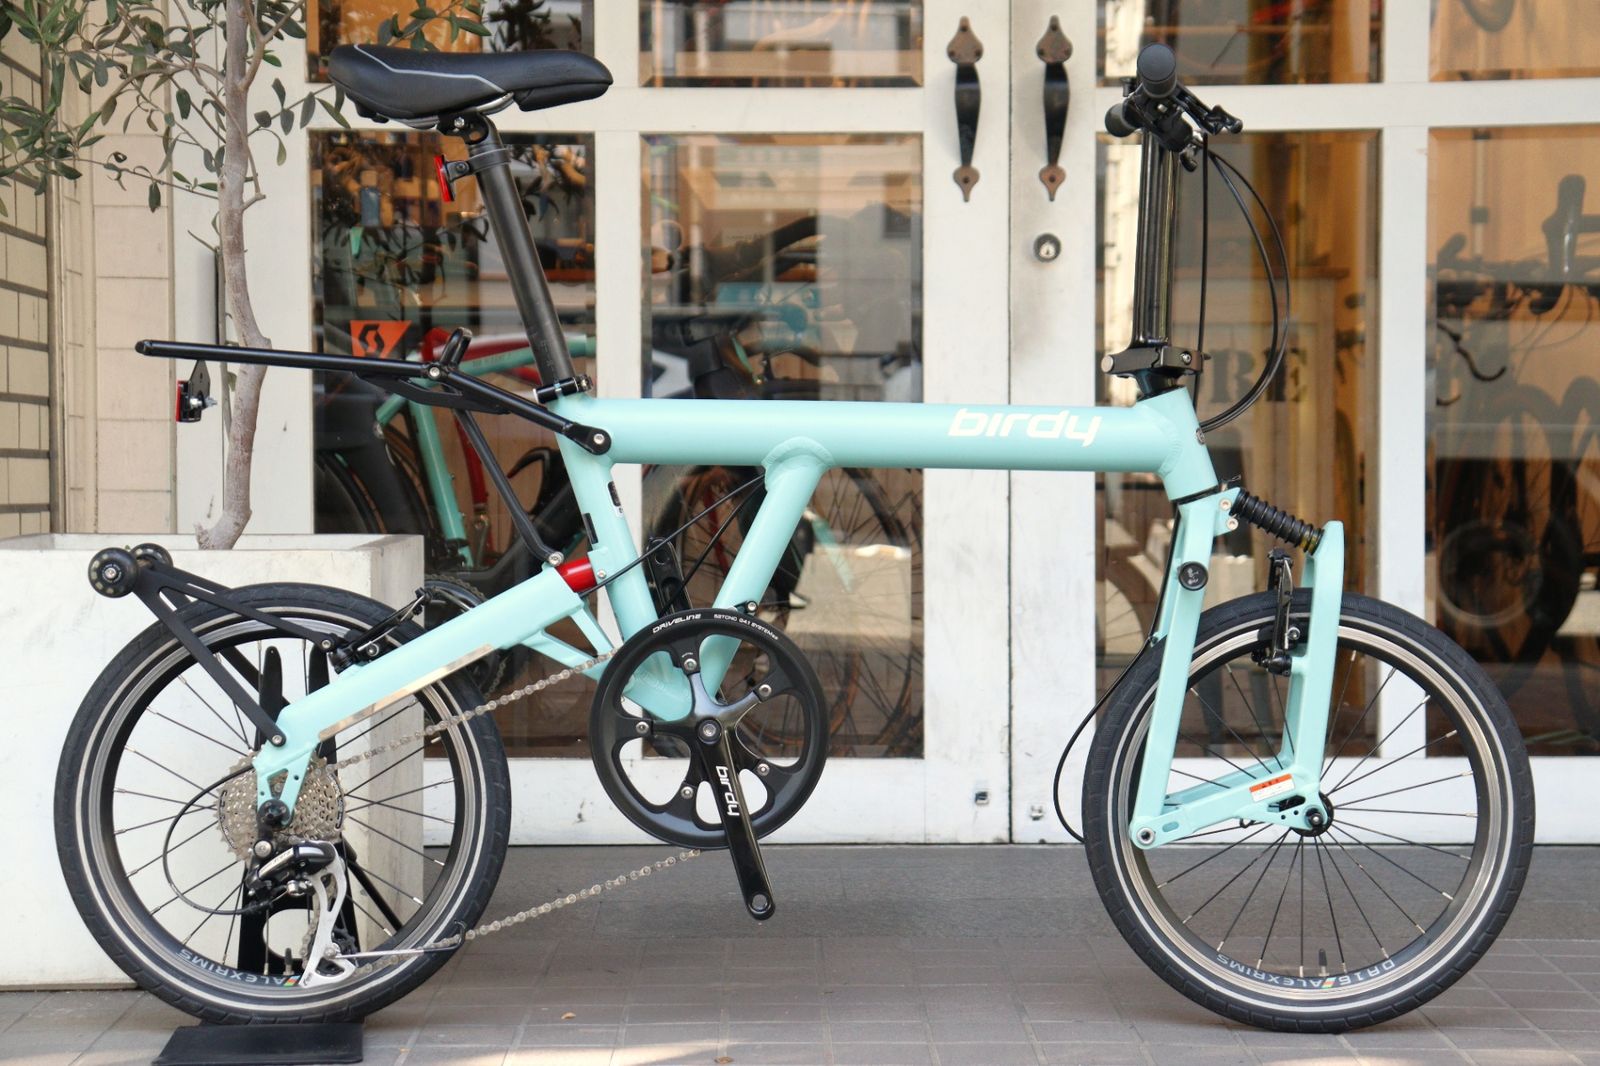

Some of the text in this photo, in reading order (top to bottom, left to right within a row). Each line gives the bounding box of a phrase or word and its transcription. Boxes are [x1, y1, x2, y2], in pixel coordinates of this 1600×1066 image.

[948, 408, 1102, 447] birdy
[715, 765, 740, 816] birdy
[176, 948, 286, 985] ALEXRIMS
[1216, 953, 1324, 988] ALEXRIMS
